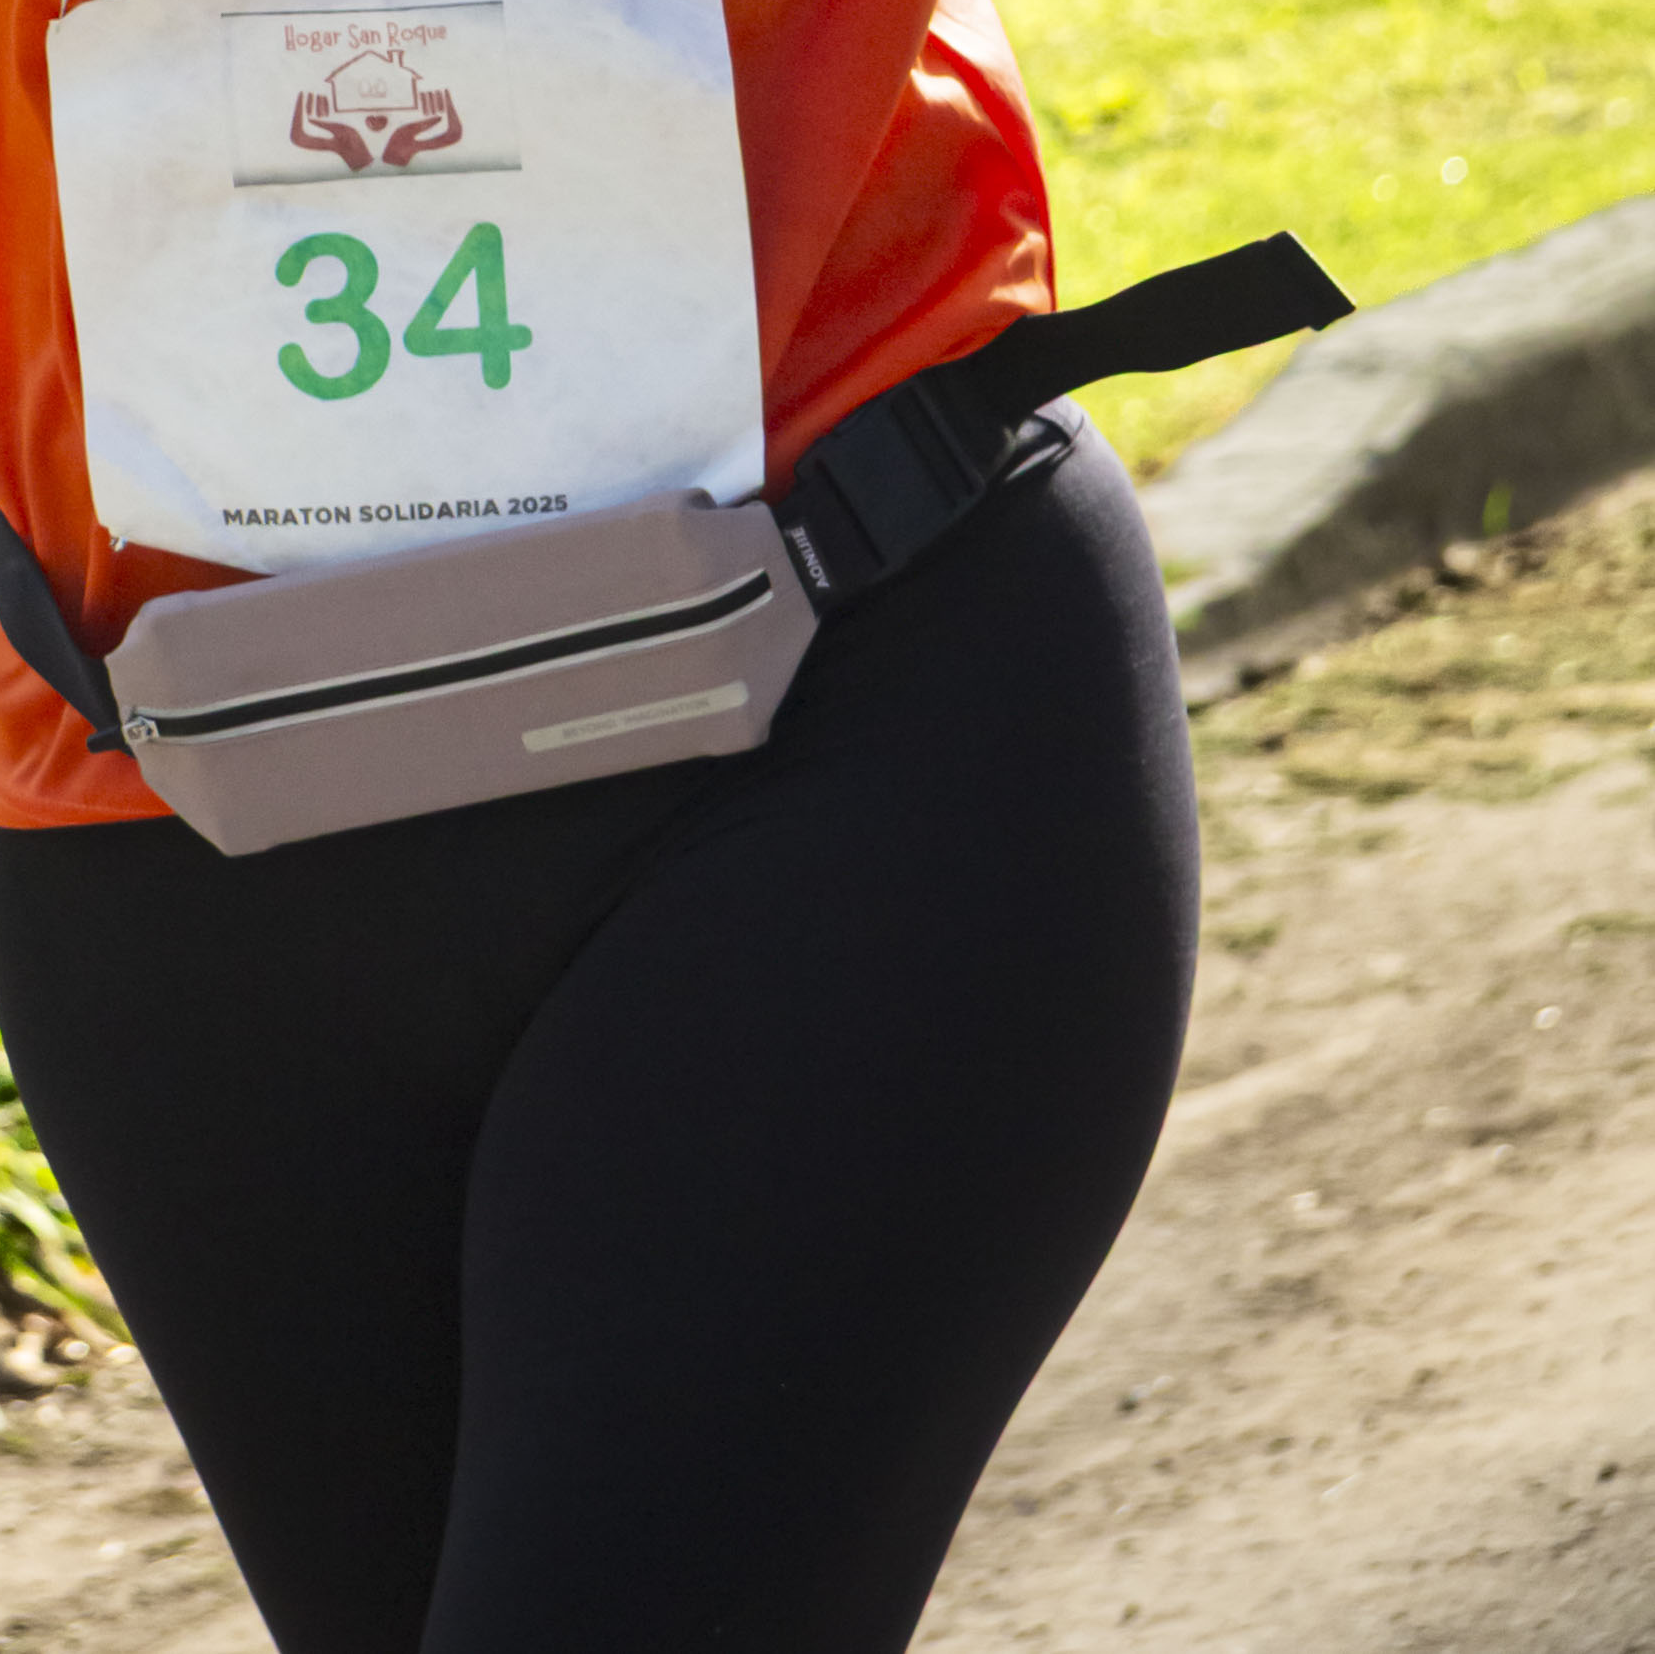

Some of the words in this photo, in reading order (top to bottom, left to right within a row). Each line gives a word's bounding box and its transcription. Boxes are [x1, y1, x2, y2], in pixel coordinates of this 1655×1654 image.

[284, 23, 341, 52] Hogar
[348, 23, 382, 49] San
[386, 21, 448, 47] Roque
[274, 222, 533, 401] 34
[222, 506, 351, 526] MARATON
[359, 498, 500, 522] SOLIDARIA
[507, 494, 568, 516] 2025
